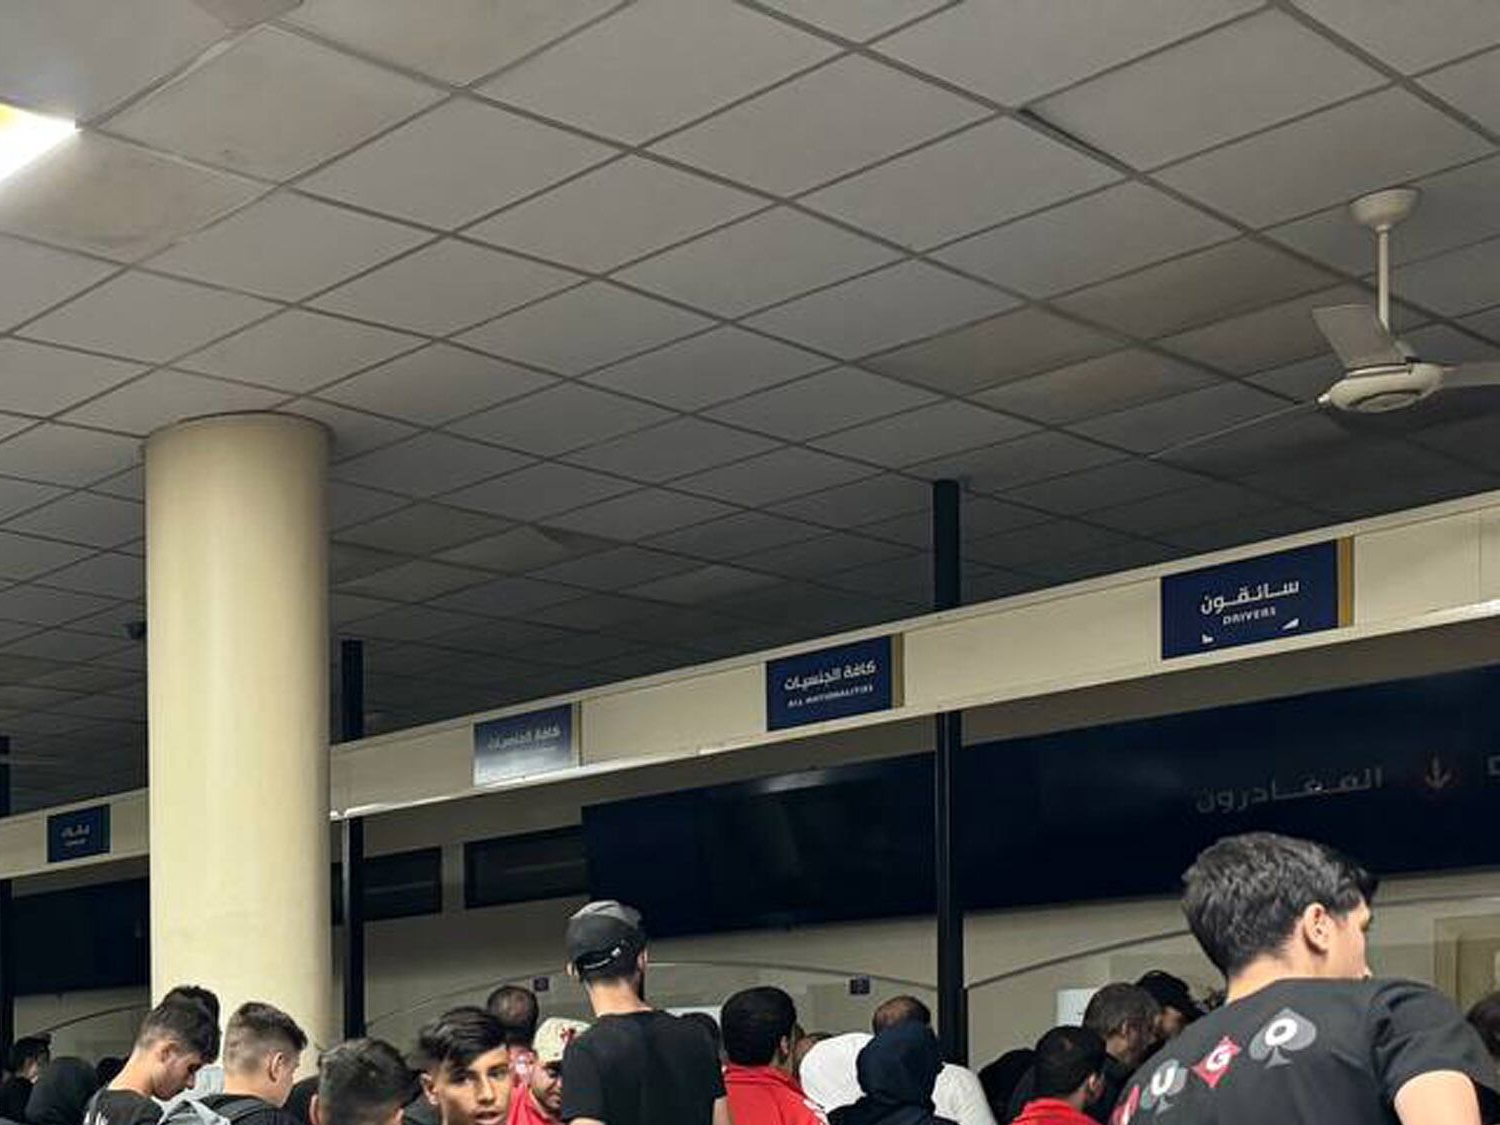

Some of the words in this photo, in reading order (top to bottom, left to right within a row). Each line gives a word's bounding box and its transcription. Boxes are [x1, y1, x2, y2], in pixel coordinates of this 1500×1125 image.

[1200, 580, 1300, 616] سائقون
[1222, 605, 1277, 626] DRIVERS
[783, 667, 842, 691] الجنسيات
[843, 660, 877, 679] كافة
[1195, 766, 1383, 814] المغادرون
